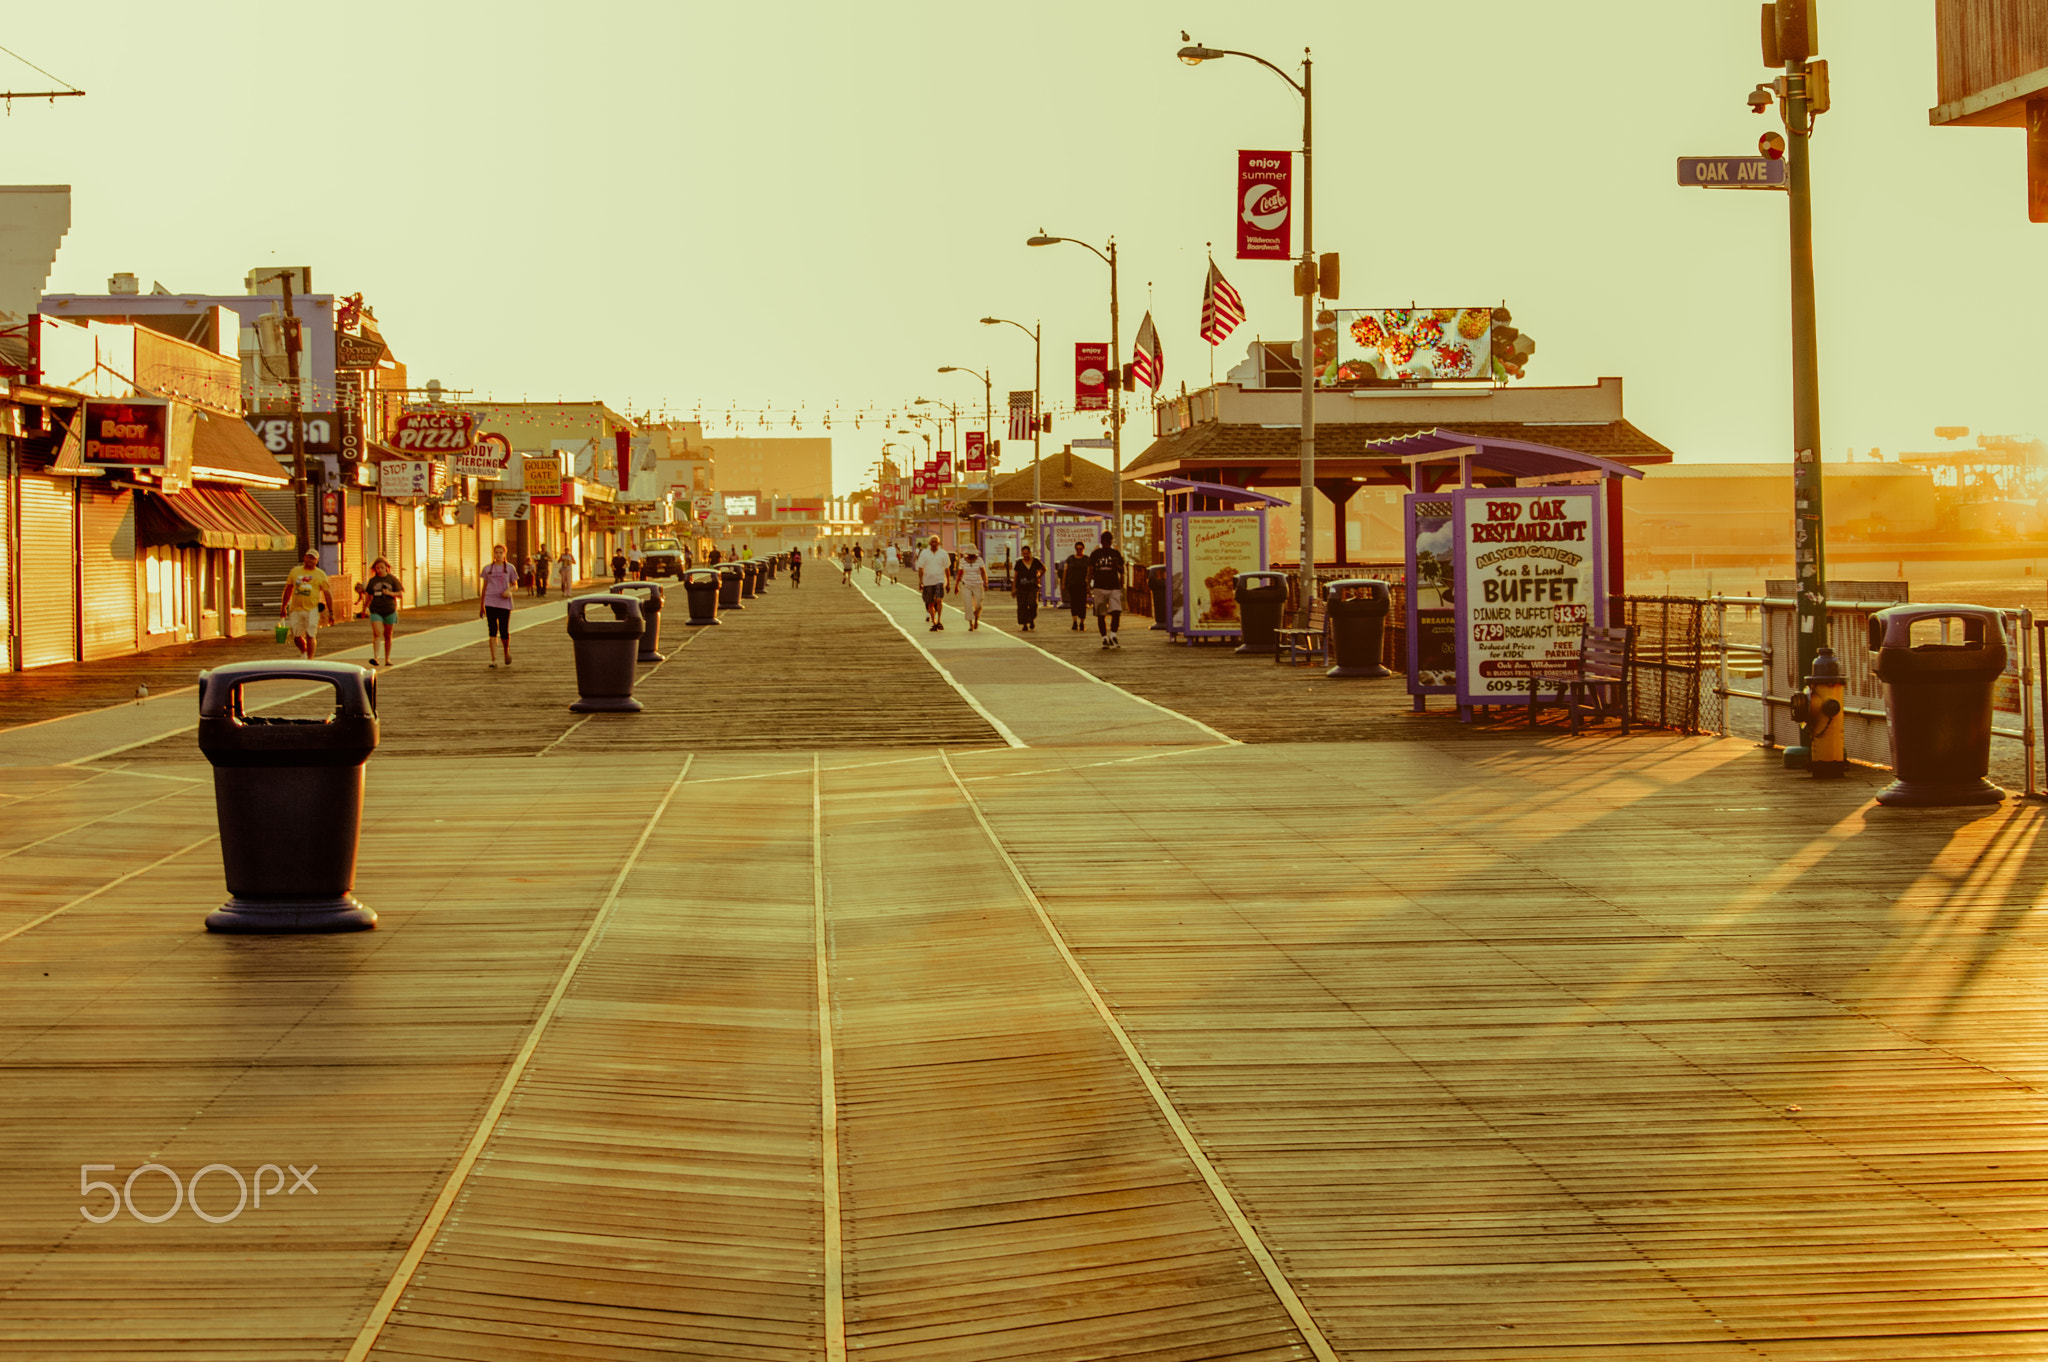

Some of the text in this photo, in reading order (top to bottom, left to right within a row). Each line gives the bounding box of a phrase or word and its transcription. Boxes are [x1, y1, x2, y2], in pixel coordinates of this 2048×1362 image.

[1249, 158, 1280, 169] enjoy
[1242, 171, 1287, 180] summer
[1696, 162, 1768, 180] OAK AVE
[408, 417, 465, 428] MACK'S
[101, 420, 148, 438] BODY
[399, 428, 467, 449] PIZZA
[87, 440, 160, 460] PIERCING
[463, 444, 494, 457] ODY
[456, 457, 498, 468] PIERCING
[525, 461, 557, 471] GOLDEN
[382, 463, 407, 476] STOP
[460, 467, 497, 476] AIRBRUSH
[530, 471, 553, 480] GATE
[1486, 499, 1567, 521] RED OAK
[1195, 523, 1236, 548] Johnson's
[1471, 521, 1587, 543] RESTAURANT
[1220, 540, 1251, 548] POPCORN
[1476, 545, 1582, 569] ALL YOU CAN EAT
[1496, 565, 1564, 576] Sea & Land
[1483, 578, 1578, 603] BUFFET
[1473, 606, 1586, 622] DINNER BUFFET $13.99
[1474, 624, 1503, 641] $7.99
[1505, 625, 1554, 638] BREAKFAST
[1479, 643, 1510, 651] Reduced
[1553, 641, 1573, 649] FREE
[1545, 650, 1581, 658] PARKING
[1531, 661, 1567, 669] Wildwood
